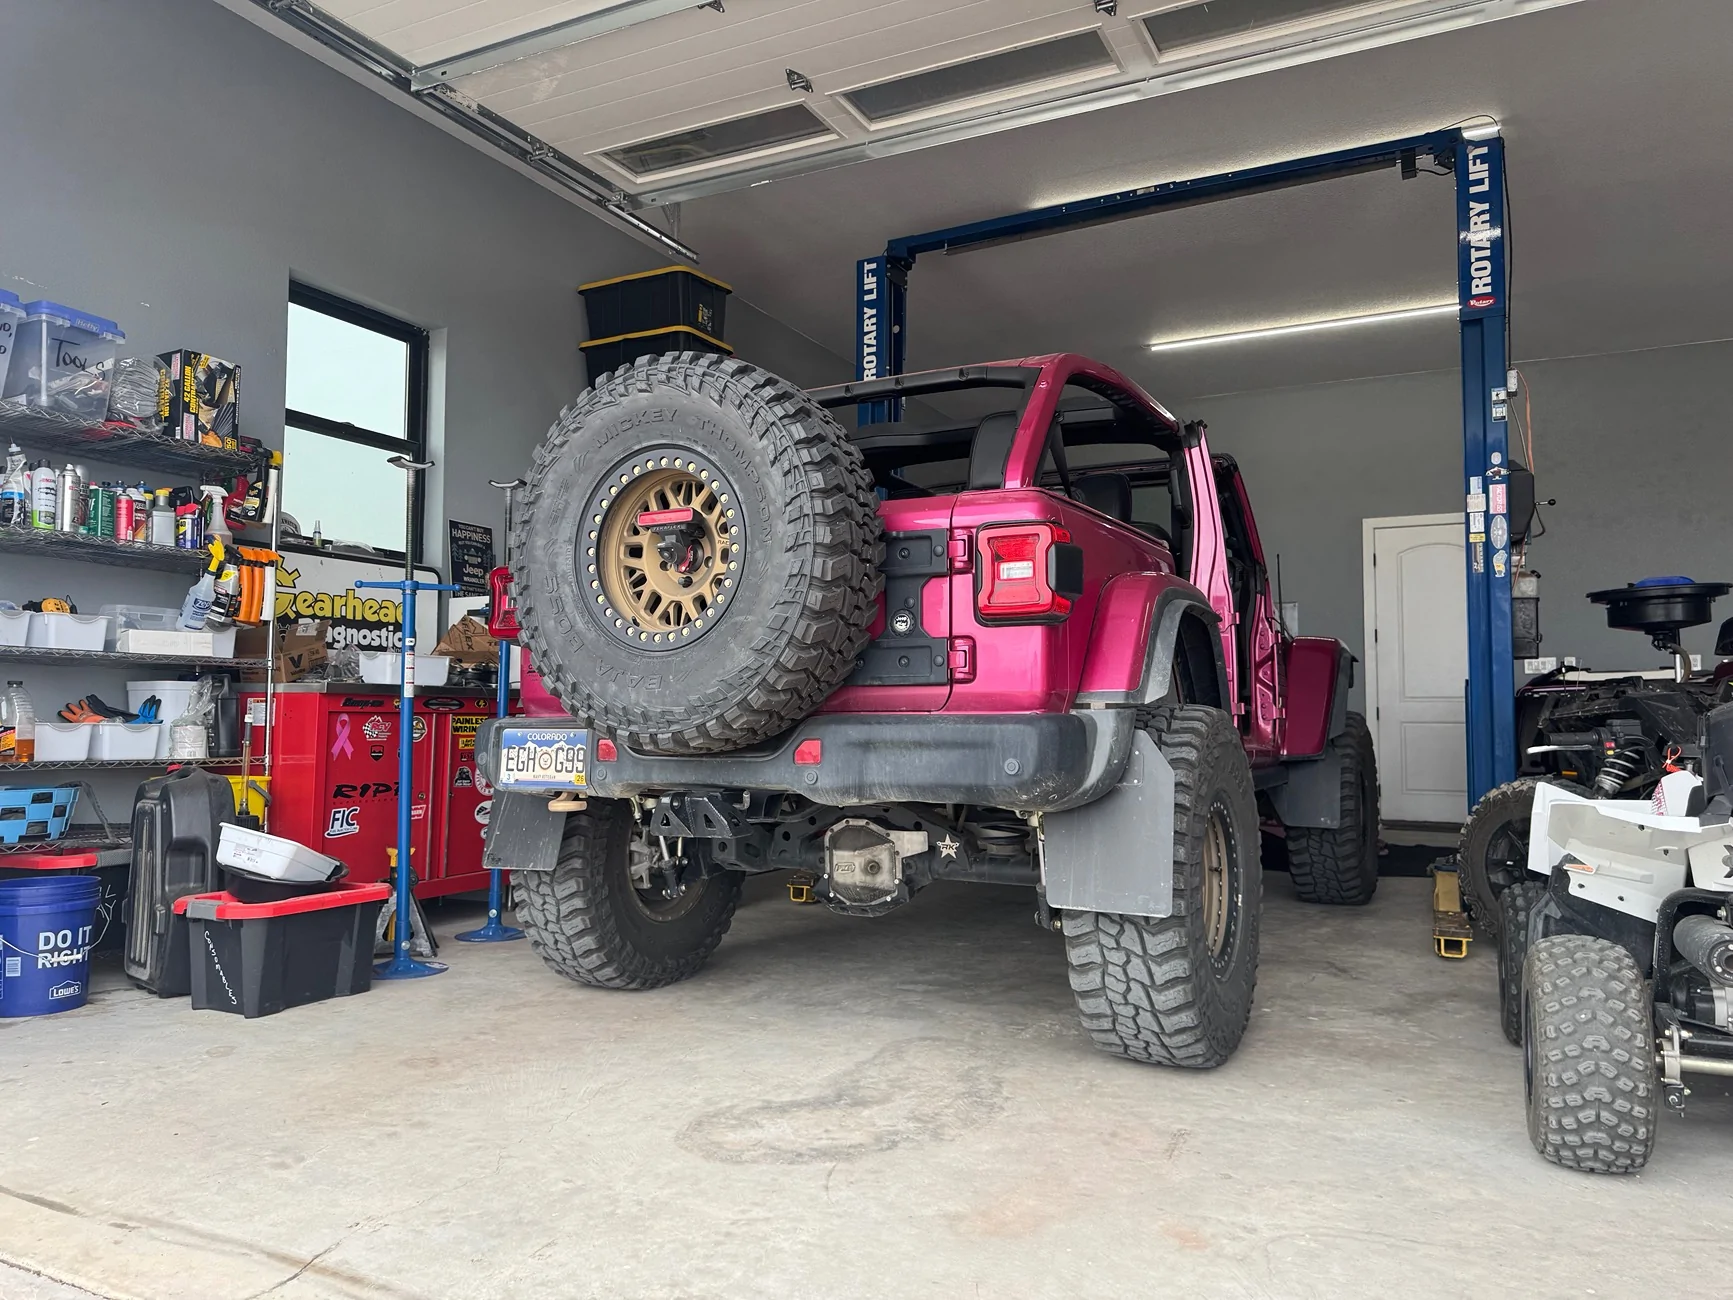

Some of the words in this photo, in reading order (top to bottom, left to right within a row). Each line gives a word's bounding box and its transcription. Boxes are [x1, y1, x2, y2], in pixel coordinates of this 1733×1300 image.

[1469, 146, 1490, 194] LIFT
[1469, 200, 1492, 296] ROTARY
[864, 261, 877, 301] LIFT
[76, 319, 99, 332] Hefty
[863, 306, 877, 381] ROTARY
[184, 365, 192, 392] GALLON
[184, 392, 191, 403] 42
[595, 407, 678, 449] MICKEY
[695, 416, 773, 543] THOMPSON
[452, 528, 491, 544] HAPPINESS
[463, 564, 484, 577] Jeep
[544, 570, 585, 653] BOSS
[596, 659, 663, 691] BAJA
[527, 732, 568, 741] COLORADO
[505, 746, 537, 773] EGH
[333, 782, 399, 799] RIP
[331, 807, 359, 830] FIC
[38, 929, 72, 951] DO
[77, 925, 92, 945] IT
[37, 946, 90, 969] RIGHT
[53, 985, 79, 997] LOWE'S
